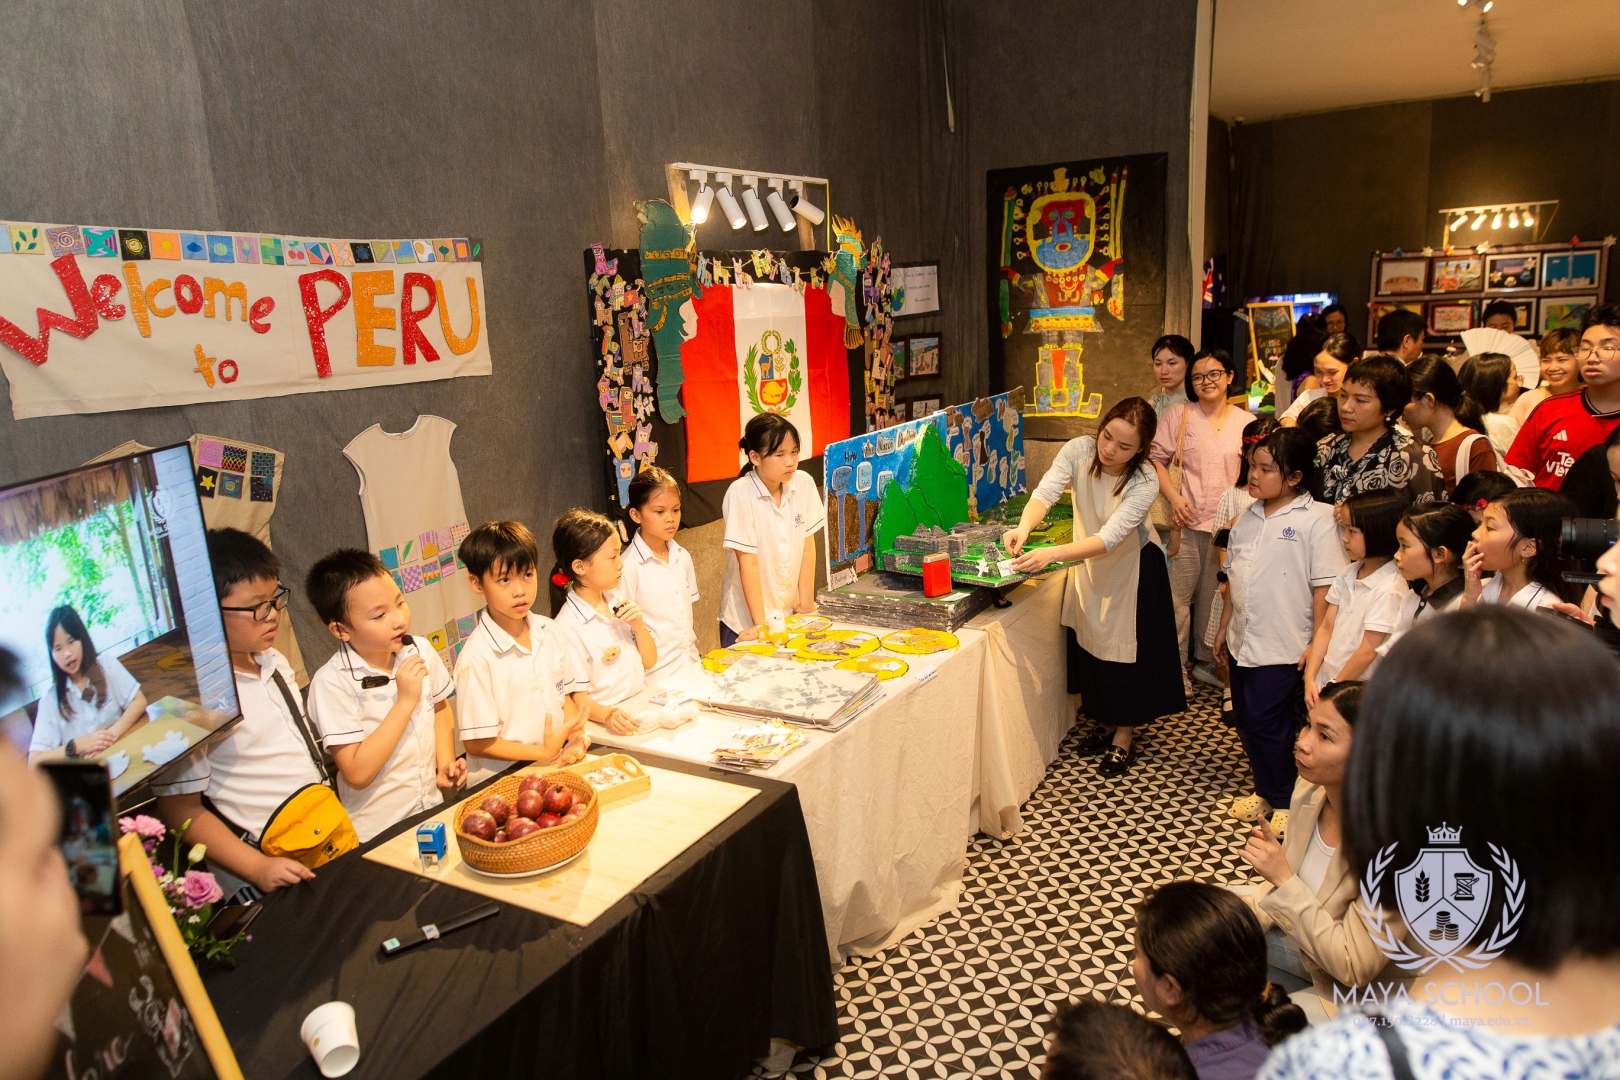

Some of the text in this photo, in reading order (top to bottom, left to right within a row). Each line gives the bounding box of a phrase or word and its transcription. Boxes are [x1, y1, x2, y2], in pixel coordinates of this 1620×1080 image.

[0, 252, 276, 366] Welcome
[298, 268, 481, 378] PERU
[193, 343, 239, 388] to
